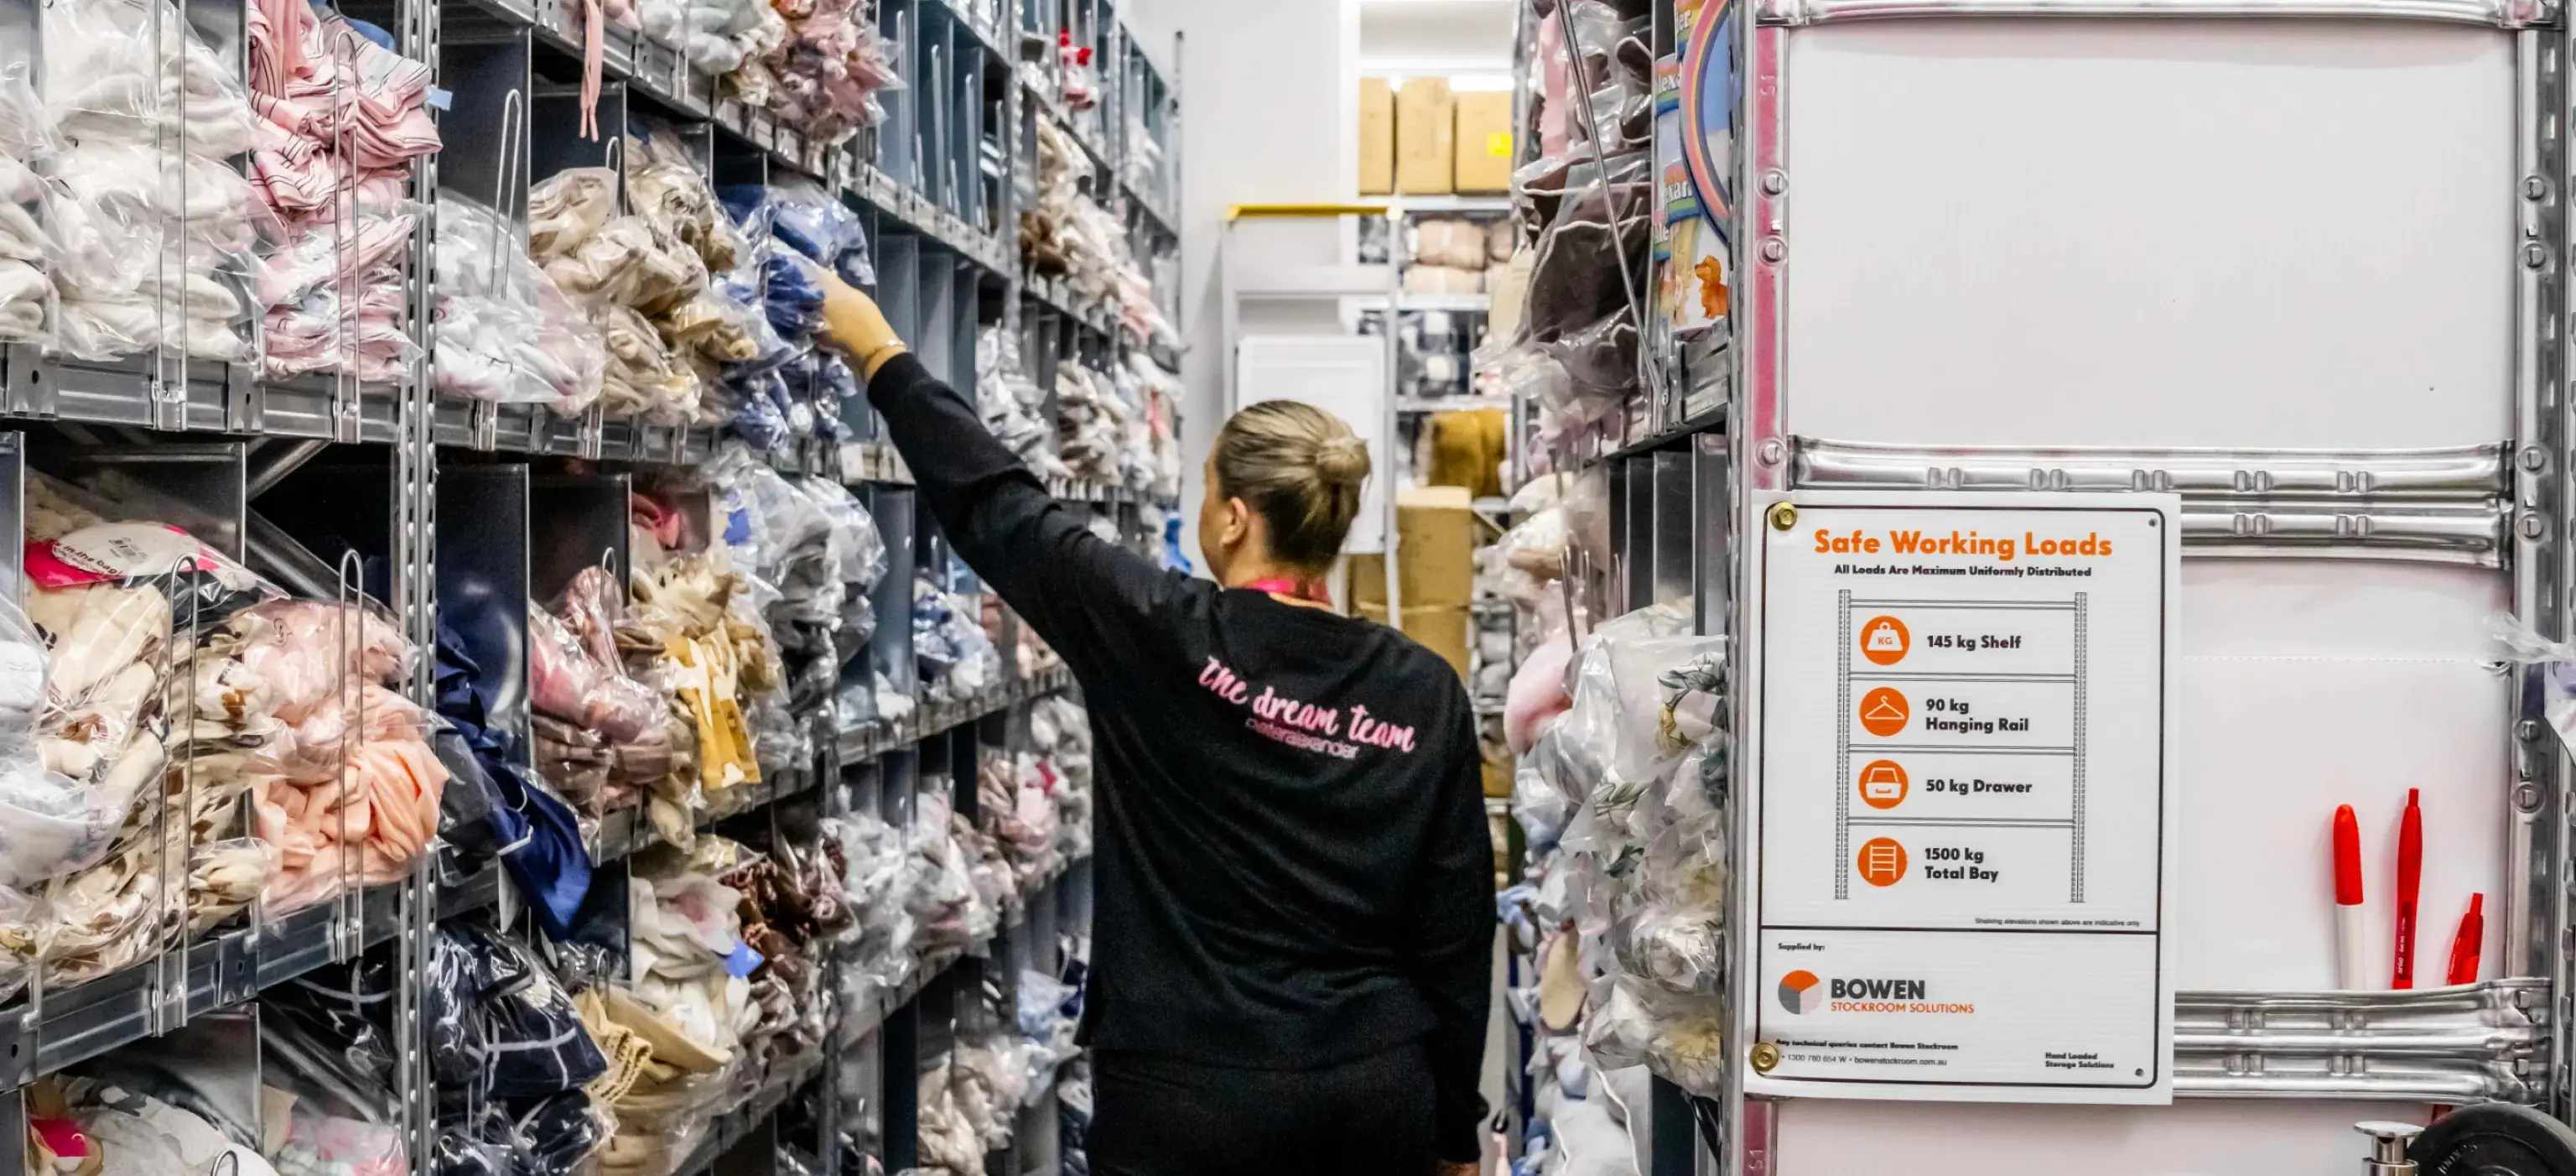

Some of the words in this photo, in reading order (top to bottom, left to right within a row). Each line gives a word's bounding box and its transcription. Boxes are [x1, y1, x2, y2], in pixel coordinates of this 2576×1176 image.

[1815, 529, 1880, 554] Safe
[1890, 531, 2014, 561] Working
[2025, 532, 2112, 556] Loads
[1835, 564, 1850, 575] All
[1852, 564, 1886, 575] Loads
[1888, 565, 1909, 575] Are
[1913, 565, 1966, 575] Maximum
[1970, 566, 2024, 577] Uniformly
[2027, 566, 2092, 577] Distributed
[1878, 637, 1893, 645] KG
[1928, 636, 1952, 648] 145
[1957, 635, 1976, 651] kg
[1981, 635, 2021, 648] Shelf
[1197, 654, 1249, 705] the
[1252, 685, 1340, 735] dream
[1348, 703, 1416, 752] team
[1926, 699, 1945, 711] 90
[1950, 699, 1969, 715] kg
[1926, 717, 1993, 734] Hanging
[1999, 718, 2028, 731] Rail
[1926, 779, 1945, 792] 50
[1950, 779, 1969, 795] kg
[1974, 779, 2032, 793] Drawer
[1925, 848, 1960, 861] 1500
[1965, 848, 1983, 864] kg
[1925, 866, 1964, 879] Total
[1970, 866, 1998, 882] Bay
[1976, 918, 2003, 926] Shelving
[1779, 942, 1812, 952] Supplied
[1813, 943, 1826, 952] by:
[1831, 979, 1924, 999] BOWEN
[1831, 1002, 1906, 1012] STOCKROOM
[1910, 1002, 1975, 1014] SOLUTIONS
[1775, 1038, 1790, 1047] Any
[1792, 1039, 1827, 1048] technical
[1828, 1041, 1858, 1049] queries
[1918, 1042, 1959, 1050] Stockroom
[1855, 1056, 1948, 1066] bowenstockroom.com.au
[2069, 1052, 2098, 1060] Loaded
[2046, 1059, 2077, 1069] Storage
[2079, 1060, 2115, 1069] Solutions
